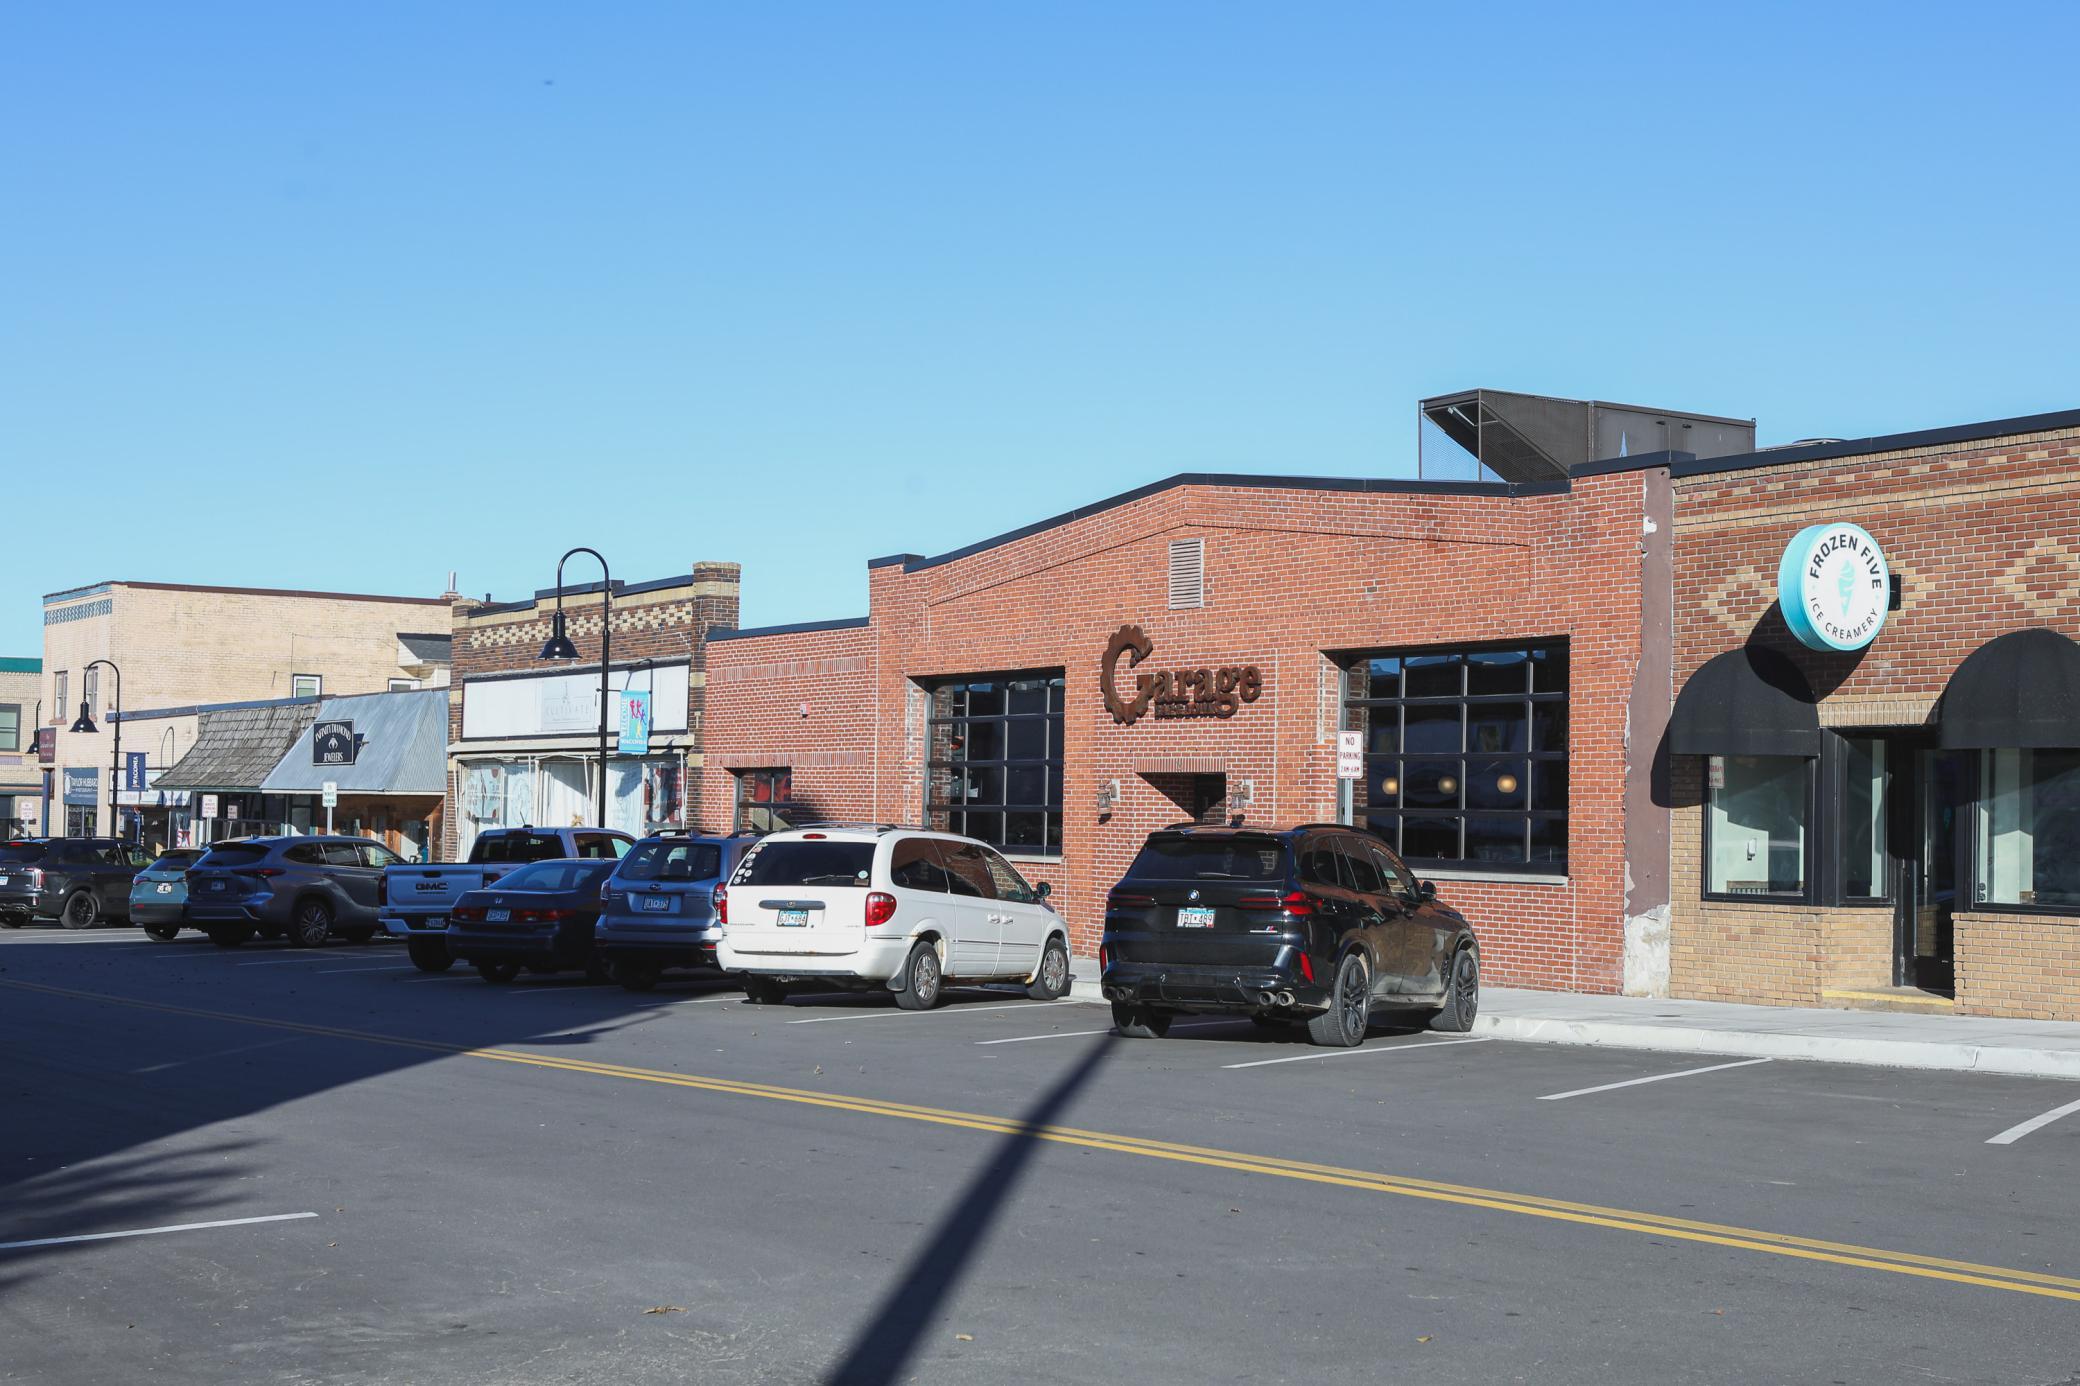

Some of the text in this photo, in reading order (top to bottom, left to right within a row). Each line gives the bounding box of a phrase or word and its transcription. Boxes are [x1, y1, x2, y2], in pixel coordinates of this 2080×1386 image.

[1810, 534, 1882, 589] FROZEN FIVE
[1810, 597, 1878, 639] ICE CREAMERY
[1101, 624, 1262, 726] Garage
[331, 723, 351, 741] DIAMOND
[1345, 737, 1354, 746] NO
[323, 752, 343, 762] JEWELERS
[1340, 752, 1360, 760] PARKING
[416, 882, 448, 890] GMC
